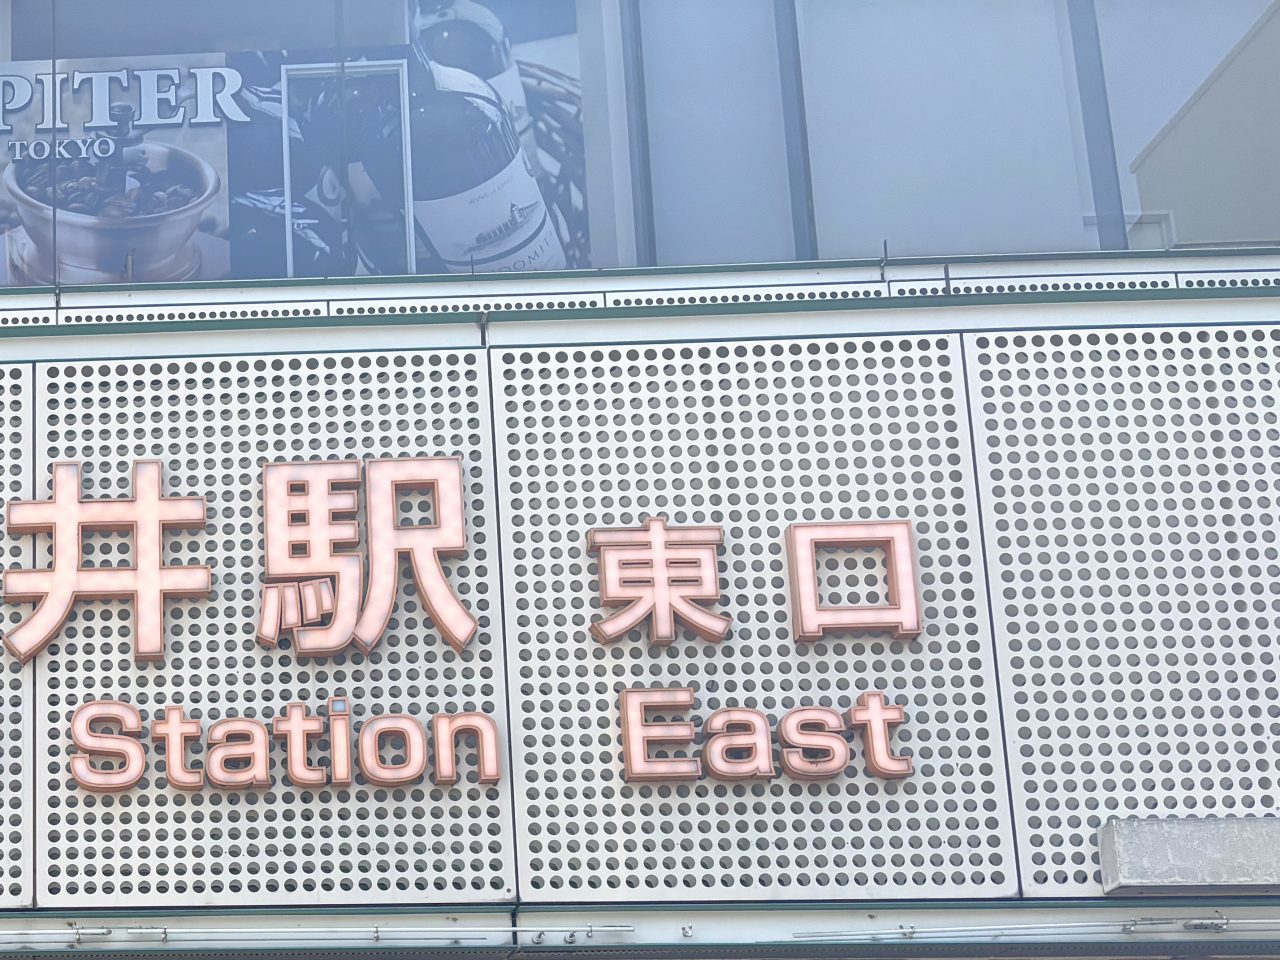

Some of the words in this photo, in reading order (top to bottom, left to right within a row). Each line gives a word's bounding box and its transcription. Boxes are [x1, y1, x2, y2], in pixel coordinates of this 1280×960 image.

[8, 137, 115, 161] TOKYO
[586, 516, 922, 647] 東口
[70, 696, 502, 793] Station
[620, 687, 913, 785] East
